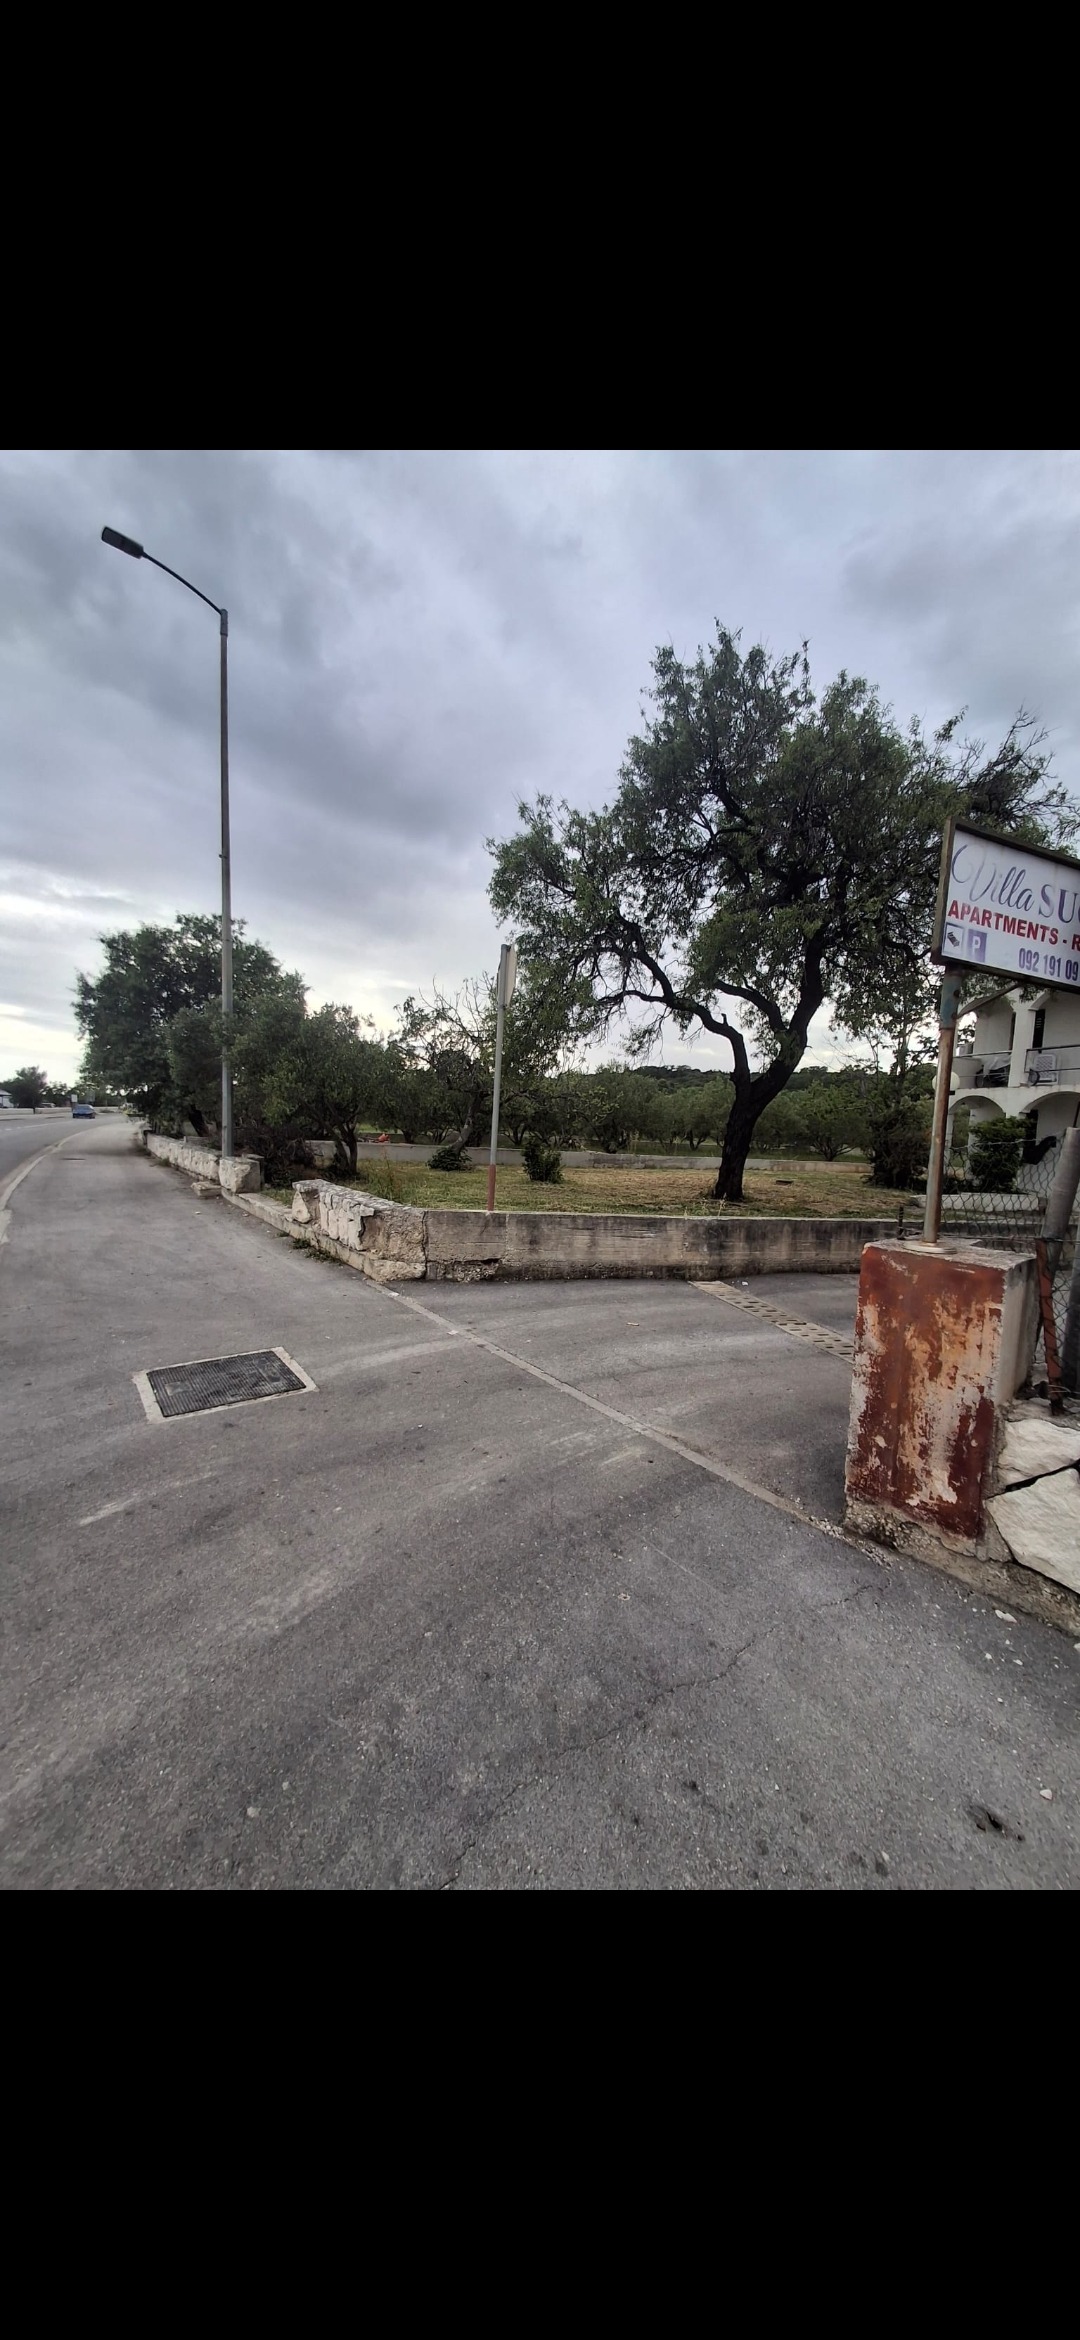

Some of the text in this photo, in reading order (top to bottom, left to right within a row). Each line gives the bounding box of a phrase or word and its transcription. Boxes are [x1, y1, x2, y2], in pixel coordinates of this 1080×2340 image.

[951, 844, 1080, 924] Villa SU
[947, 899, 1059, 945] APARTMENTS
[971, 936, 981, 958] P
[1018, 947, 1079, 981] 092 191 09
